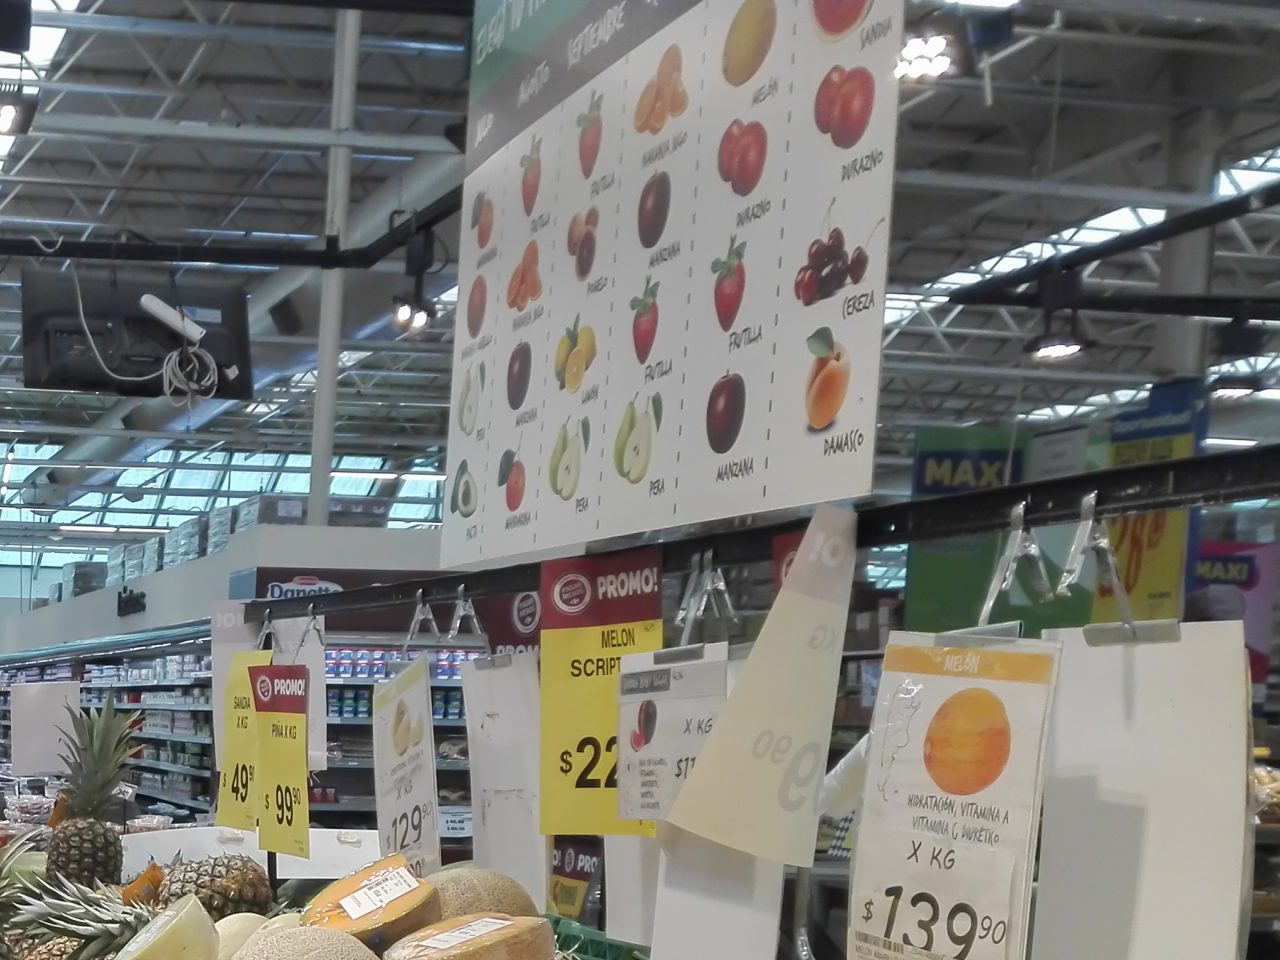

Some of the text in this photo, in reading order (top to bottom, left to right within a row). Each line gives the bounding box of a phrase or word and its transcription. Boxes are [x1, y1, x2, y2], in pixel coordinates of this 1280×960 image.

[841, 148, 884, 183] DURAZNO
[736, 200, 771, 228] DURAZNO
[842, 290, 875, 320] CEREZA
[729, 324, 763, 354] FRUTILLA
[644, 359, 673, 385] FRUTILLA
[824, 428, 865, 457] DAMASCO
[716, 456, 755, 483] MANZANA
[649, 478, 665, 498] PERA
[596, 566, 659, 601] PROMO!
[1196, 560, 1250, 582] MAXI
[601, 627, 636, 649] MELON
[943, 653, 981, 674] MELÓN
[274, 678, 305, 697] PROMO!
[272, 720, 284, 738] PIÑA
[289, 726, 297, 740] KG
[683, 718, 713, 735] X KG
[231, 763, 249, 803] 49
[276, 784, 294, 827] 99
[961, 802, 1000, 823] VITAMINA
[1002, 810, 1010, 824] A
[912, 816, 950, 836] VITAMINA
[906, 840, 956, 870] X KG
[861, 899, 874, 923] $
[978, 915, 1008, 945] 90
